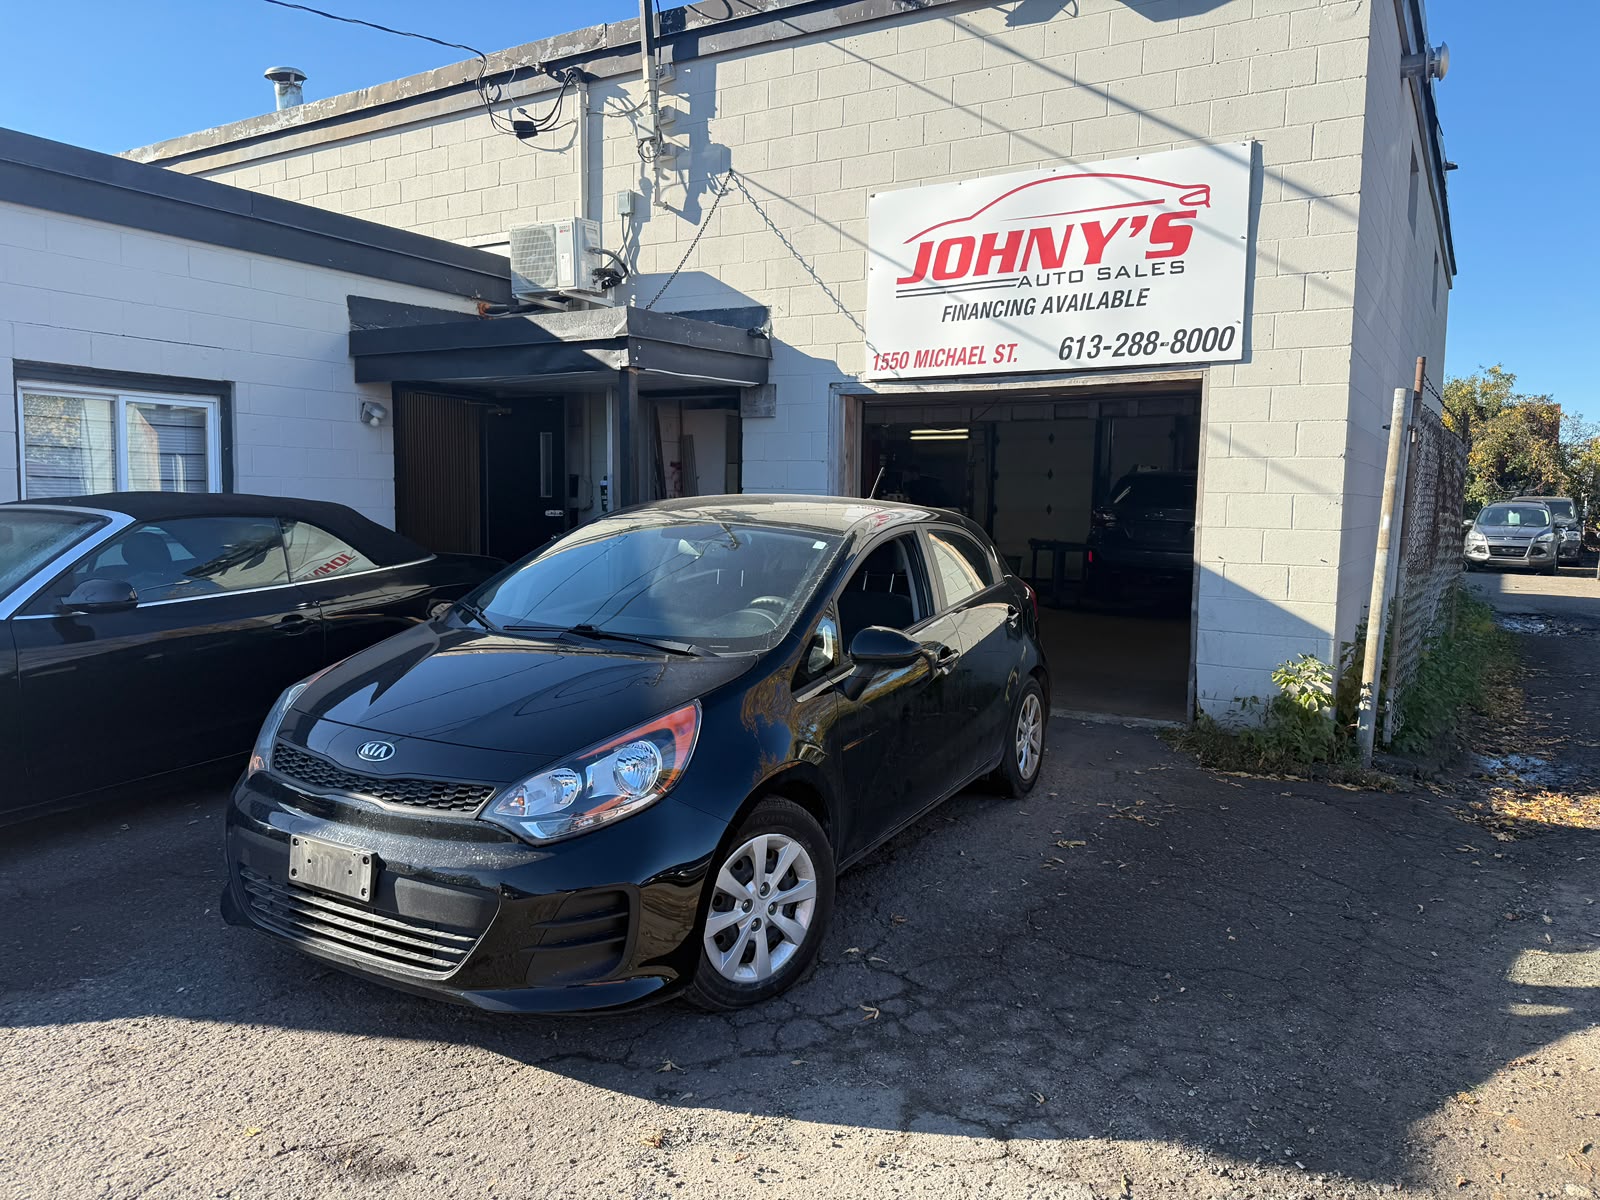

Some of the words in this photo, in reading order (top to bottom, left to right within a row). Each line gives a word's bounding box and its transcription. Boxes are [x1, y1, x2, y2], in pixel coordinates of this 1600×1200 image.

[896, 210, 1197, 285] JOHNY'S
[1017, 269, 1084, 289] AUTO
[1097, 260, 1185, 281] SALES
[941, 297, 1037, 323] FINANCING
[1041, 287, 1151, 315] AVAILABLE
[873, 350, 910, 371] 1550
[913, 345, 987, 369] MICHAEL
[993, 343, 1018, 364] ST.
[1058, 325, 1236, 361] 613-288-8000
[360, 743, 388, 758] KIA
